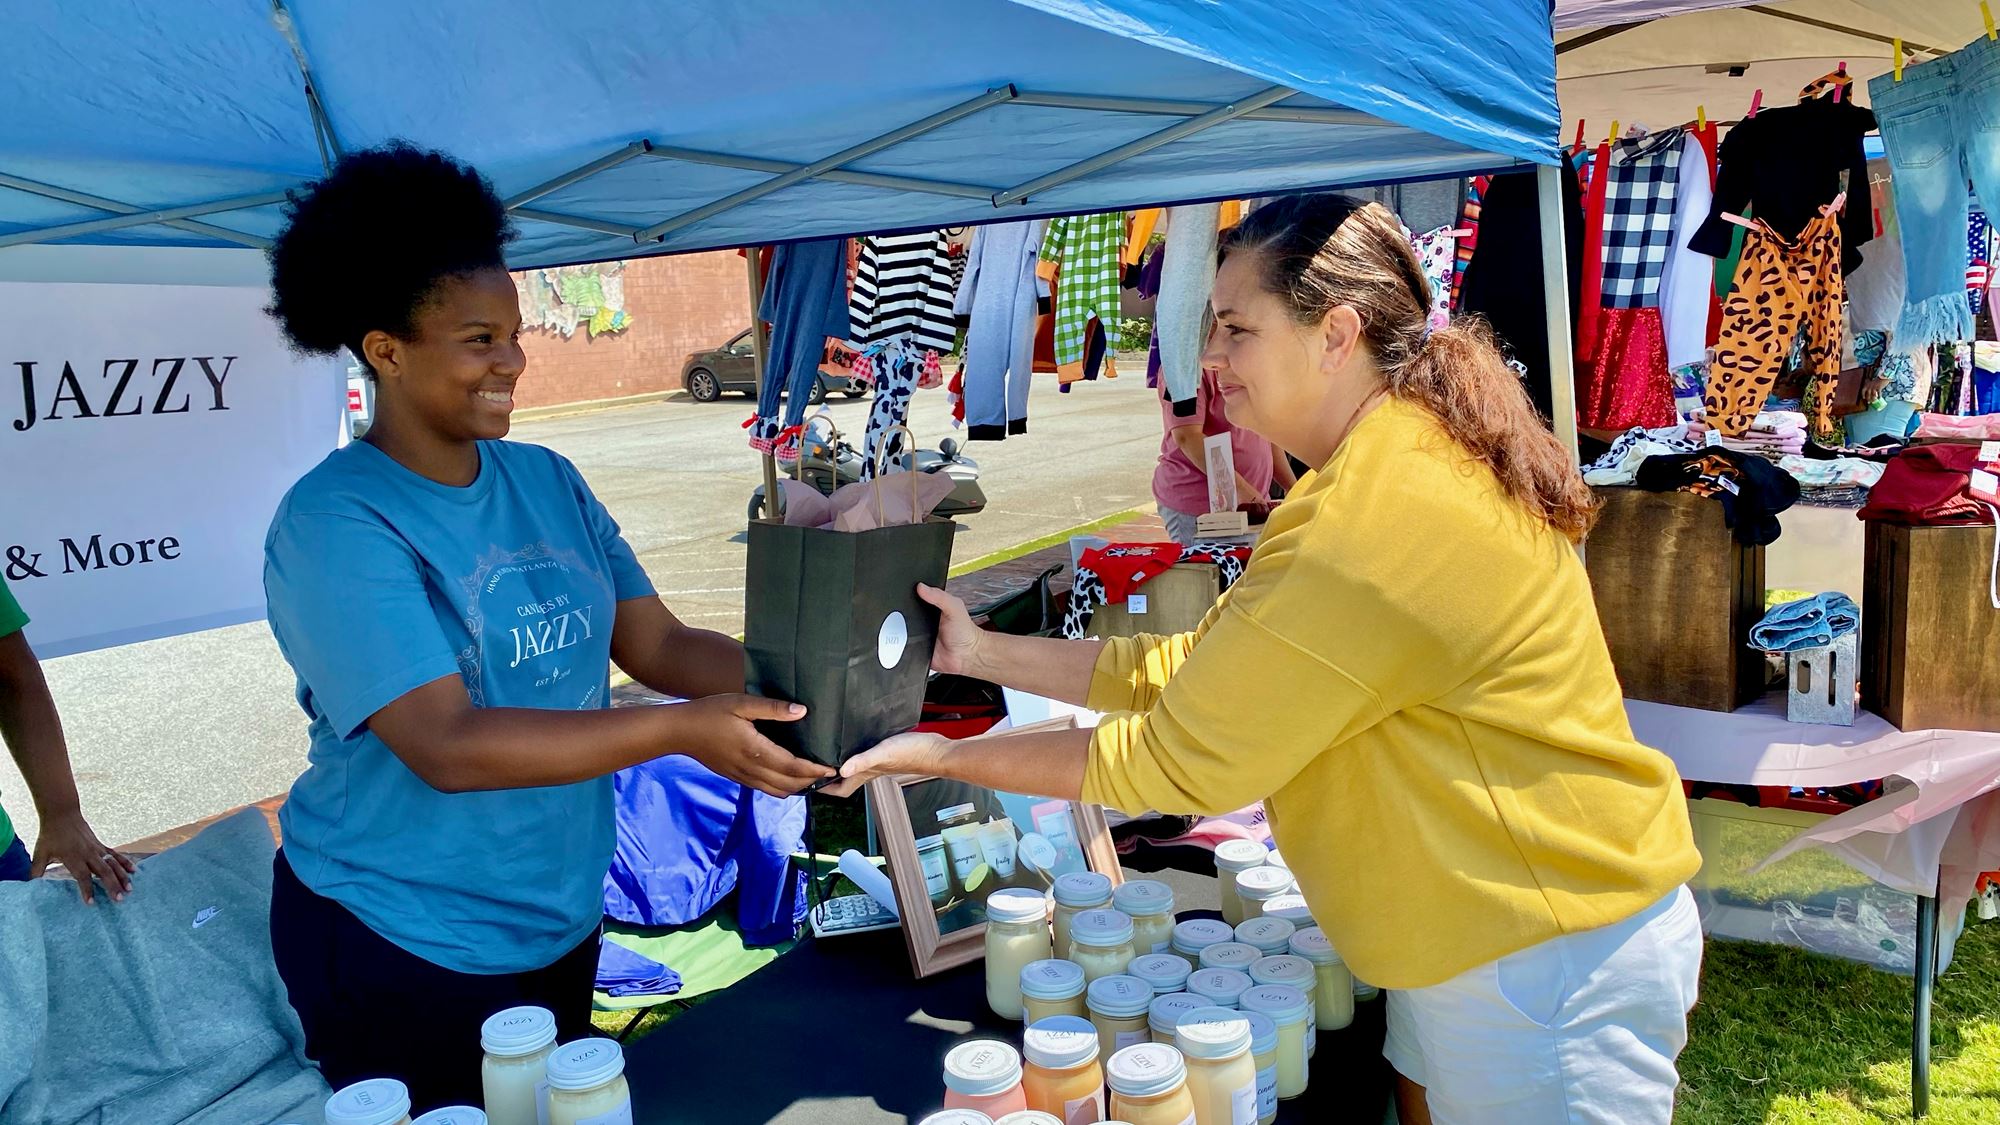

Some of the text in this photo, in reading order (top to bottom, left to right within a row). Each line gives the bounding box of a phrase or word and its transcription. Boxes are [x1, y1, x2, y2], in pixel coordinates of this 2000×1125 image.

[13, 356, 238, 431] JAZZY
[5, 534, 181, 581] & More
[554, 593, 570, 607] BY
[509, 605, 593, 668] JAZZY
